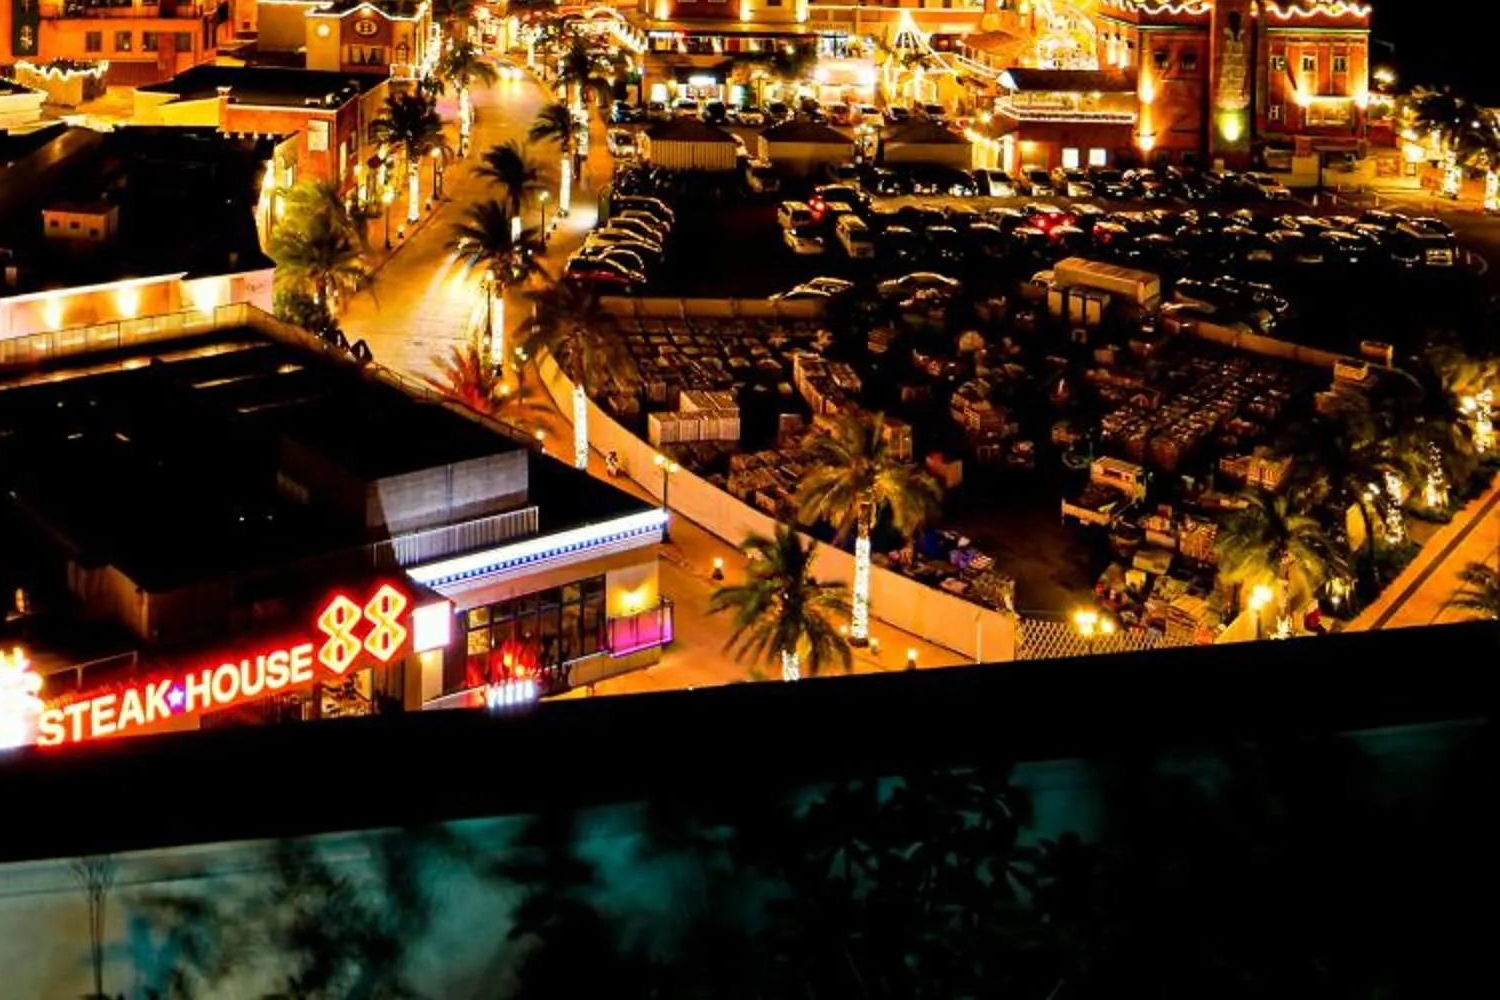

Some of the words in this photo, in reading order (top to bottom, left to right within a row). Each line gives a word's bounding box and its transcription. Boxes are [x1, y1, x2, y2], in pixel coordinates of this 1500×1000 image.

[36, 679, 173, 746] STEAK
[185, 643, 314, 712] HOUSE
[317, 584, 407, 674] 88
